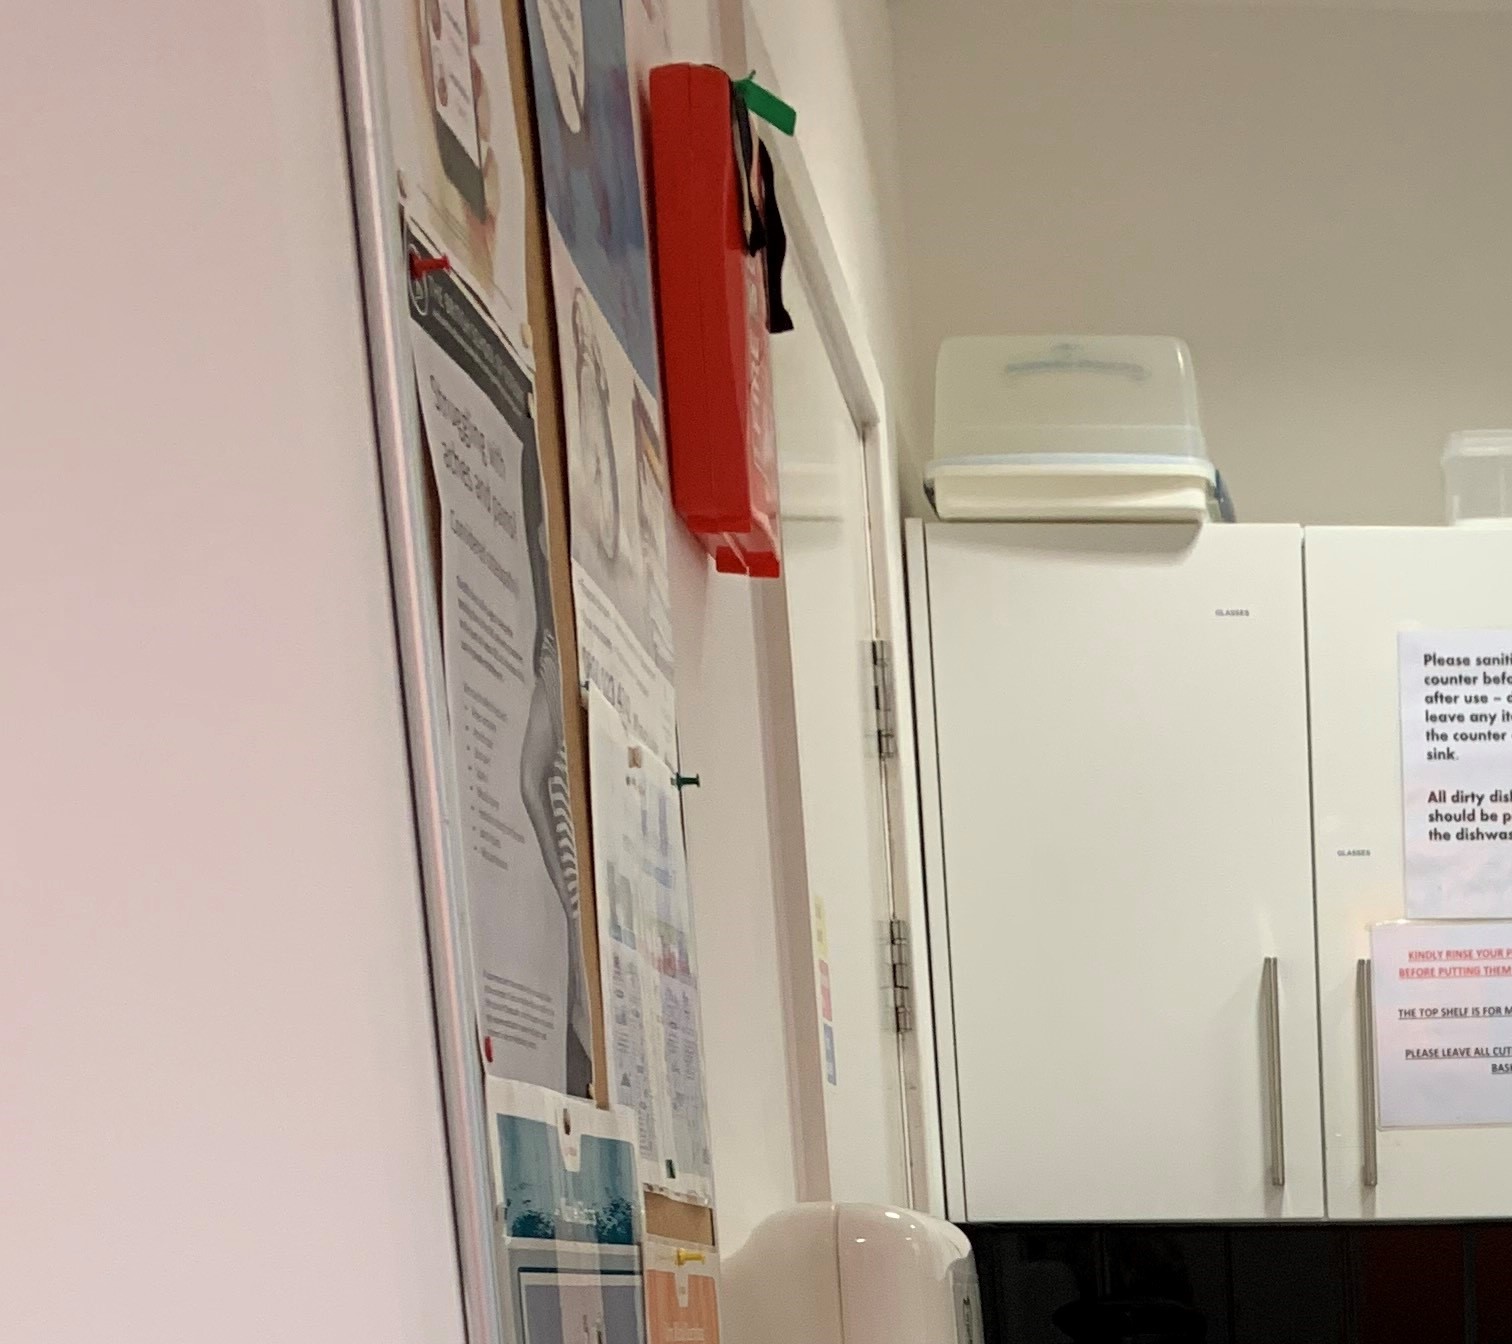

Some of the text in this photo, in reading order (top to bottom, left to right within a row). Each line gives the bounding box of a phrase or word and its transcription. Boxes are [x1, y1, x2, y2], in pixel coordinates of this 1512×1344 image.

[1424, 653, 1470, 666] Please
[1424, 674, 1478, 685] counter
[1425, 691, 1459, 704] after
[1464, 693, 1488, 704] use
[1425, 710, 1465, 722] leave
[1470, 713, 1497, 726] any
[1426, 729, 1448, 741] the
[1453, 730, 1507, 741] counter
[1427, 748, 1459, 761] sink.
[1428, 790, 1446, 803] All
[1451, 790, 1485, 806] dirty
[1428, 809, 1476, 822] should
[1480, 809, 1498, 822] be
[1429, 828, 1451, 841] the
[1408, 950, 1443, 960] KINDLY
[1446, 949, 1473, 959] RINSE
[1476, 948, 1501, 958] YOUR
[1399, 968, 1435, 977] BEFORE
[1439, 967, 1480, 976] PUTTING
[1484, 966, 1511, 975] THEM
[1398, 1008, 1416, 1017] THE
[1419, 1008, 1438, 1017] TOP
[1441, 1007, 1468, 1016] SHELF
[1472, 1007, 1480, 1016] IS
[1483, 1006, 1501, 1016] FOR
[1405, 1049, 1439, 1058] PLEASE
[1442, 1048, 1471, 1057] LEAVE
[1474, 1047, 1490, 1056] ALL
